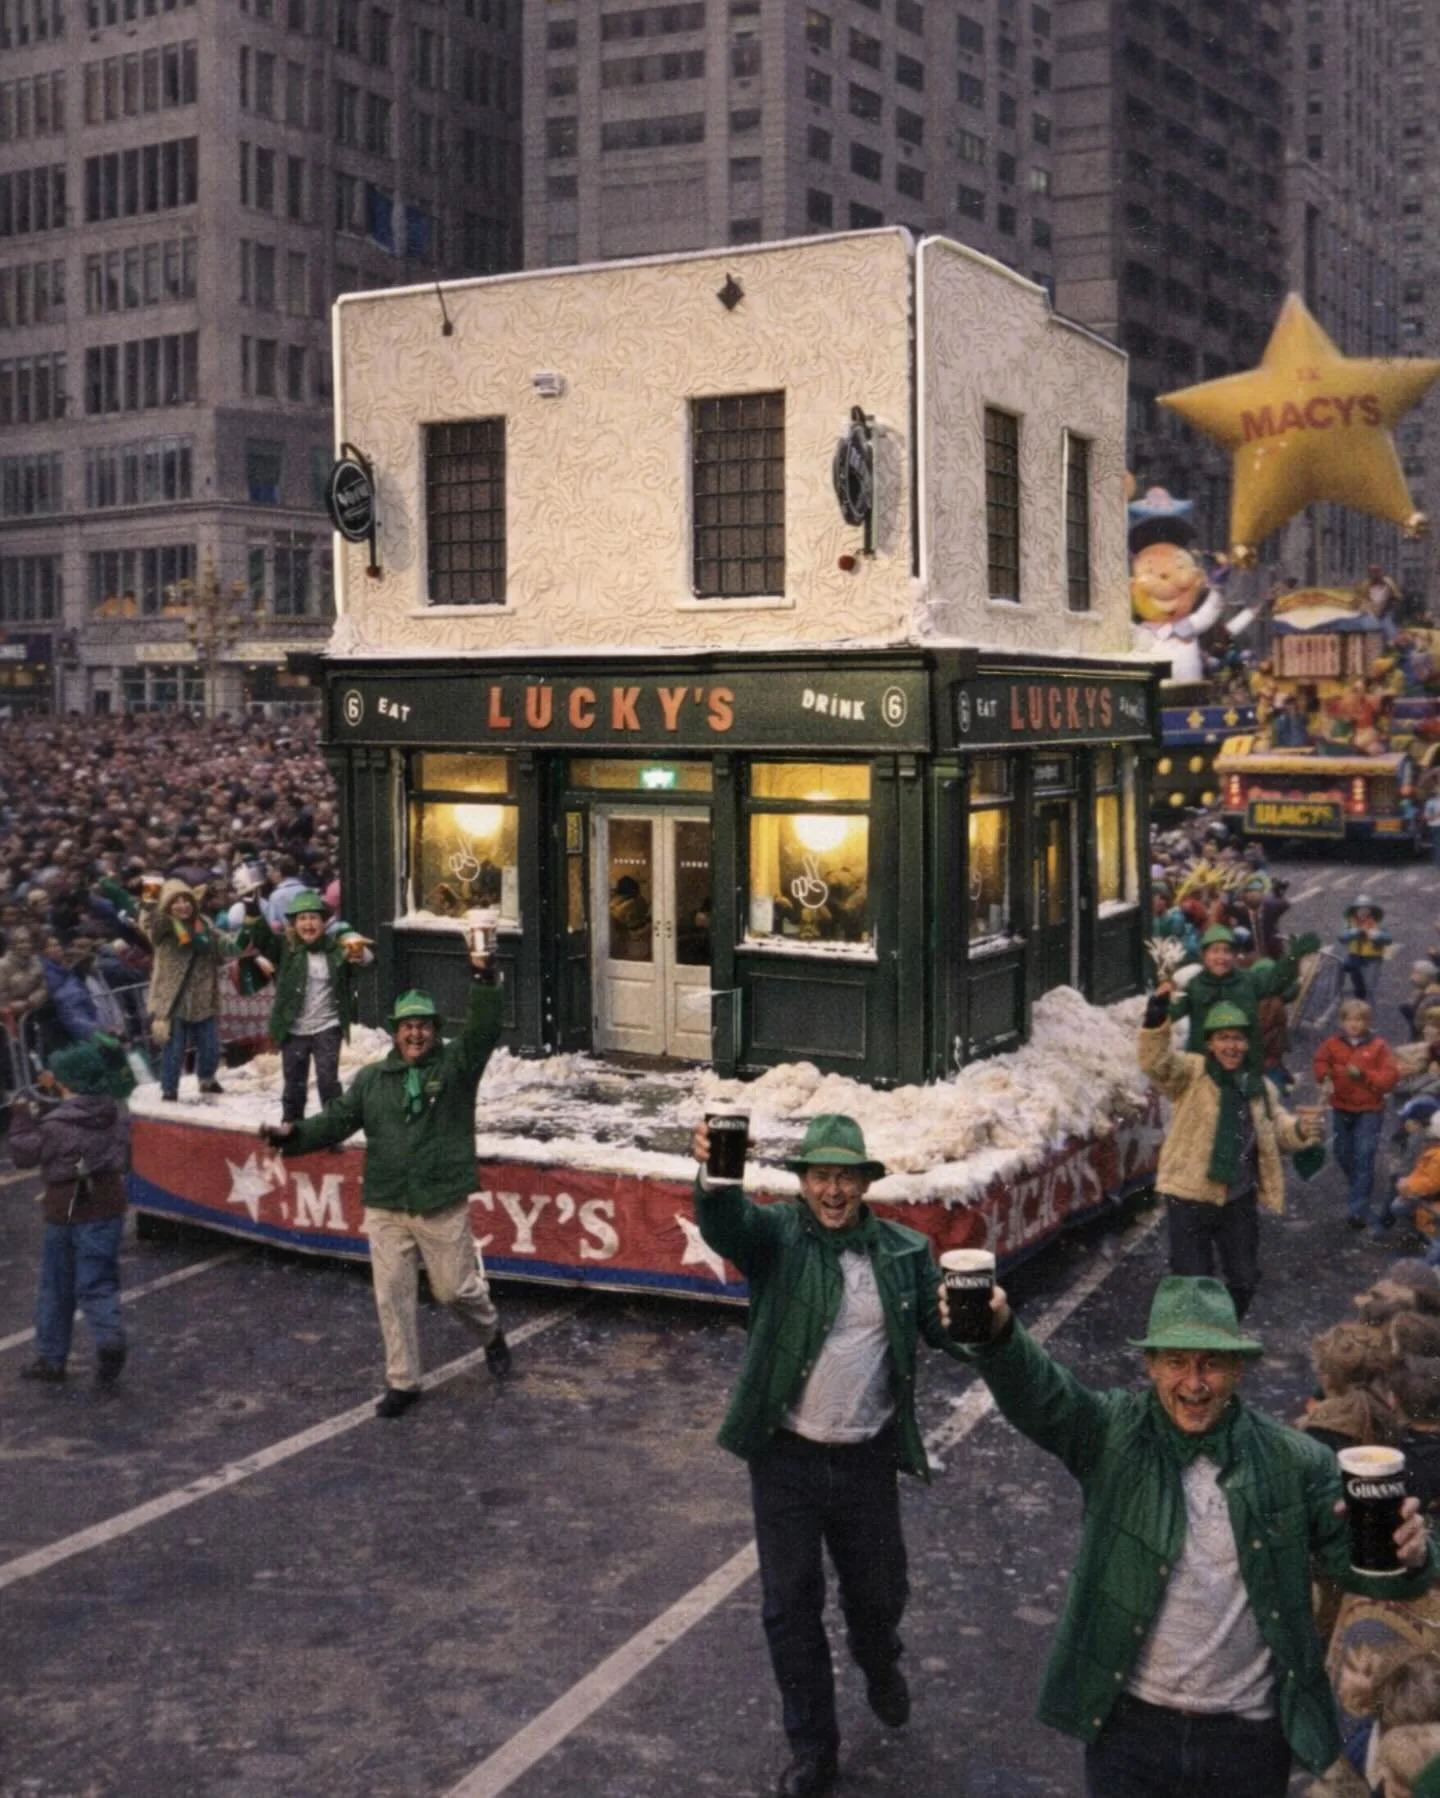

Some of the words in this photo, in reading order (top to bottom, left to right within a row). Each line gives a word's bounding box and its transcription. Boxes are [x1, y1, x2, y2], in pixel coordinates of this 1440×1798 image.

[1240, 394, 1381, 442] MACYS
[377, 697, 411, 722] EAT
[488, 686, 734, 732] LUCKY'S
[289, 1171, 620, 1260] MCY'S
